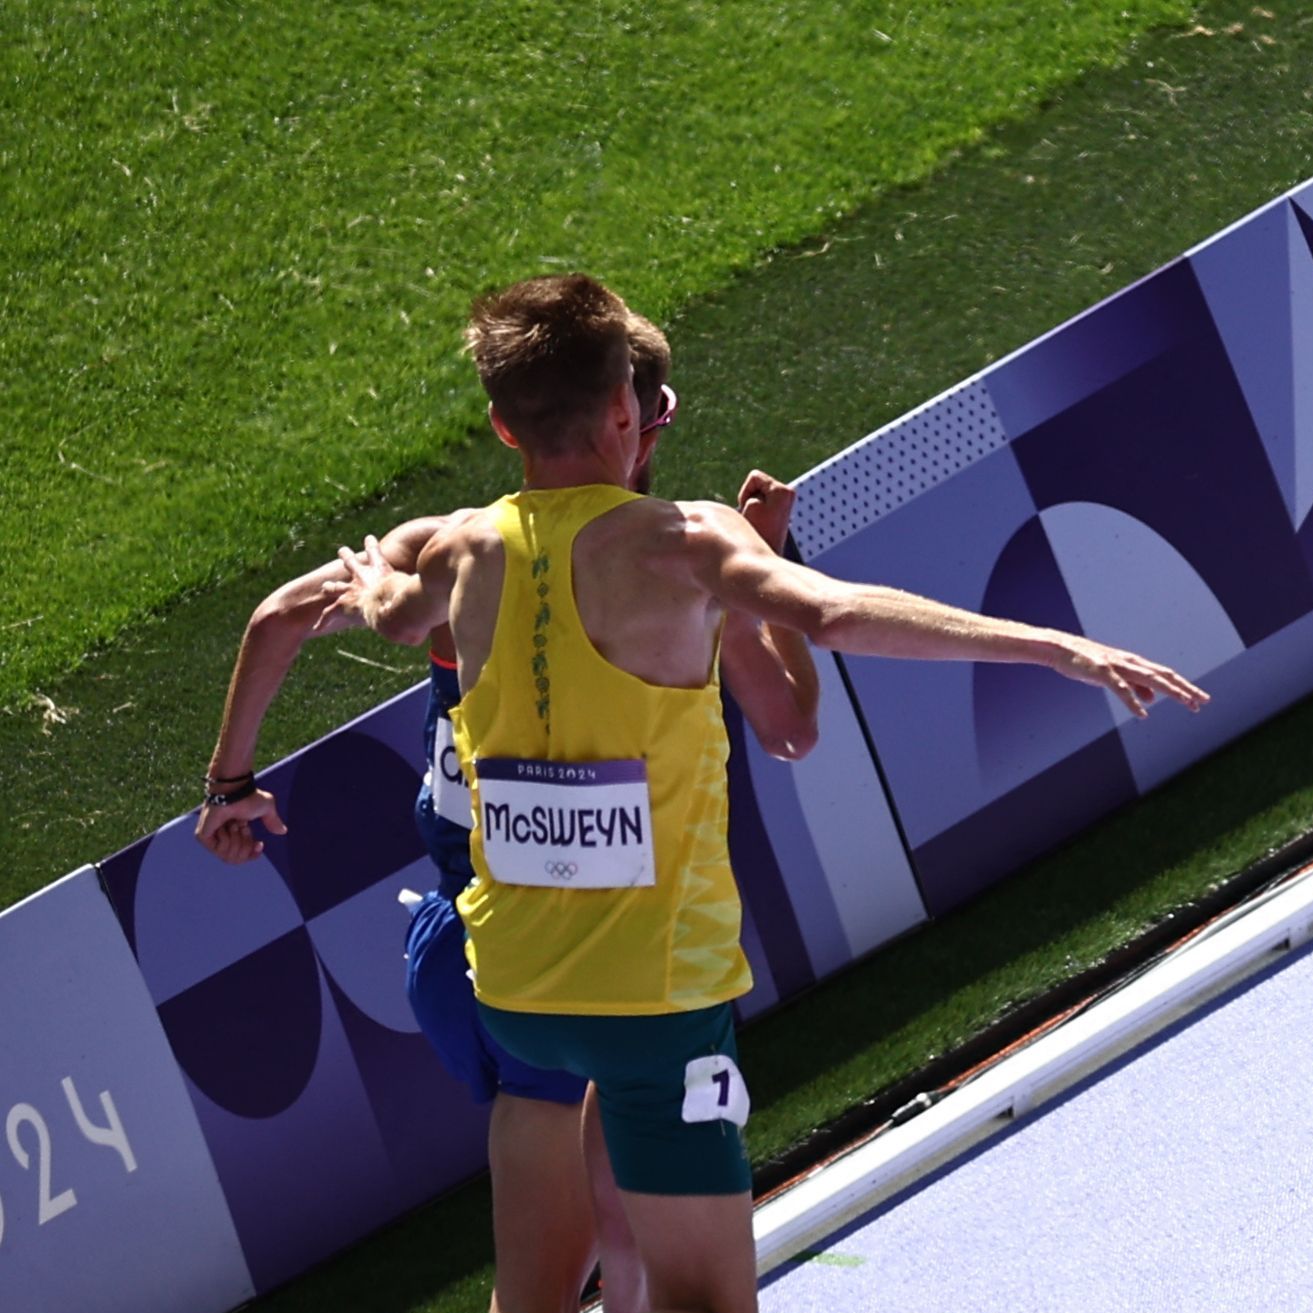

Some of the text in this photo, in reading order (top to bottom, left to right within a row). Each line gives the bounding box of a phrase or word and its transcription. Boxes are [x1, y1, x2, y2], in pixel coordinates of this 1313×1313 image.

[517, 763, 596, 781] PARIS 2024
[484, 802, 643, 847] McSWEYN
[712, 1069, 729, 1107] 1
[0, 1075, 138, 1247] 24
